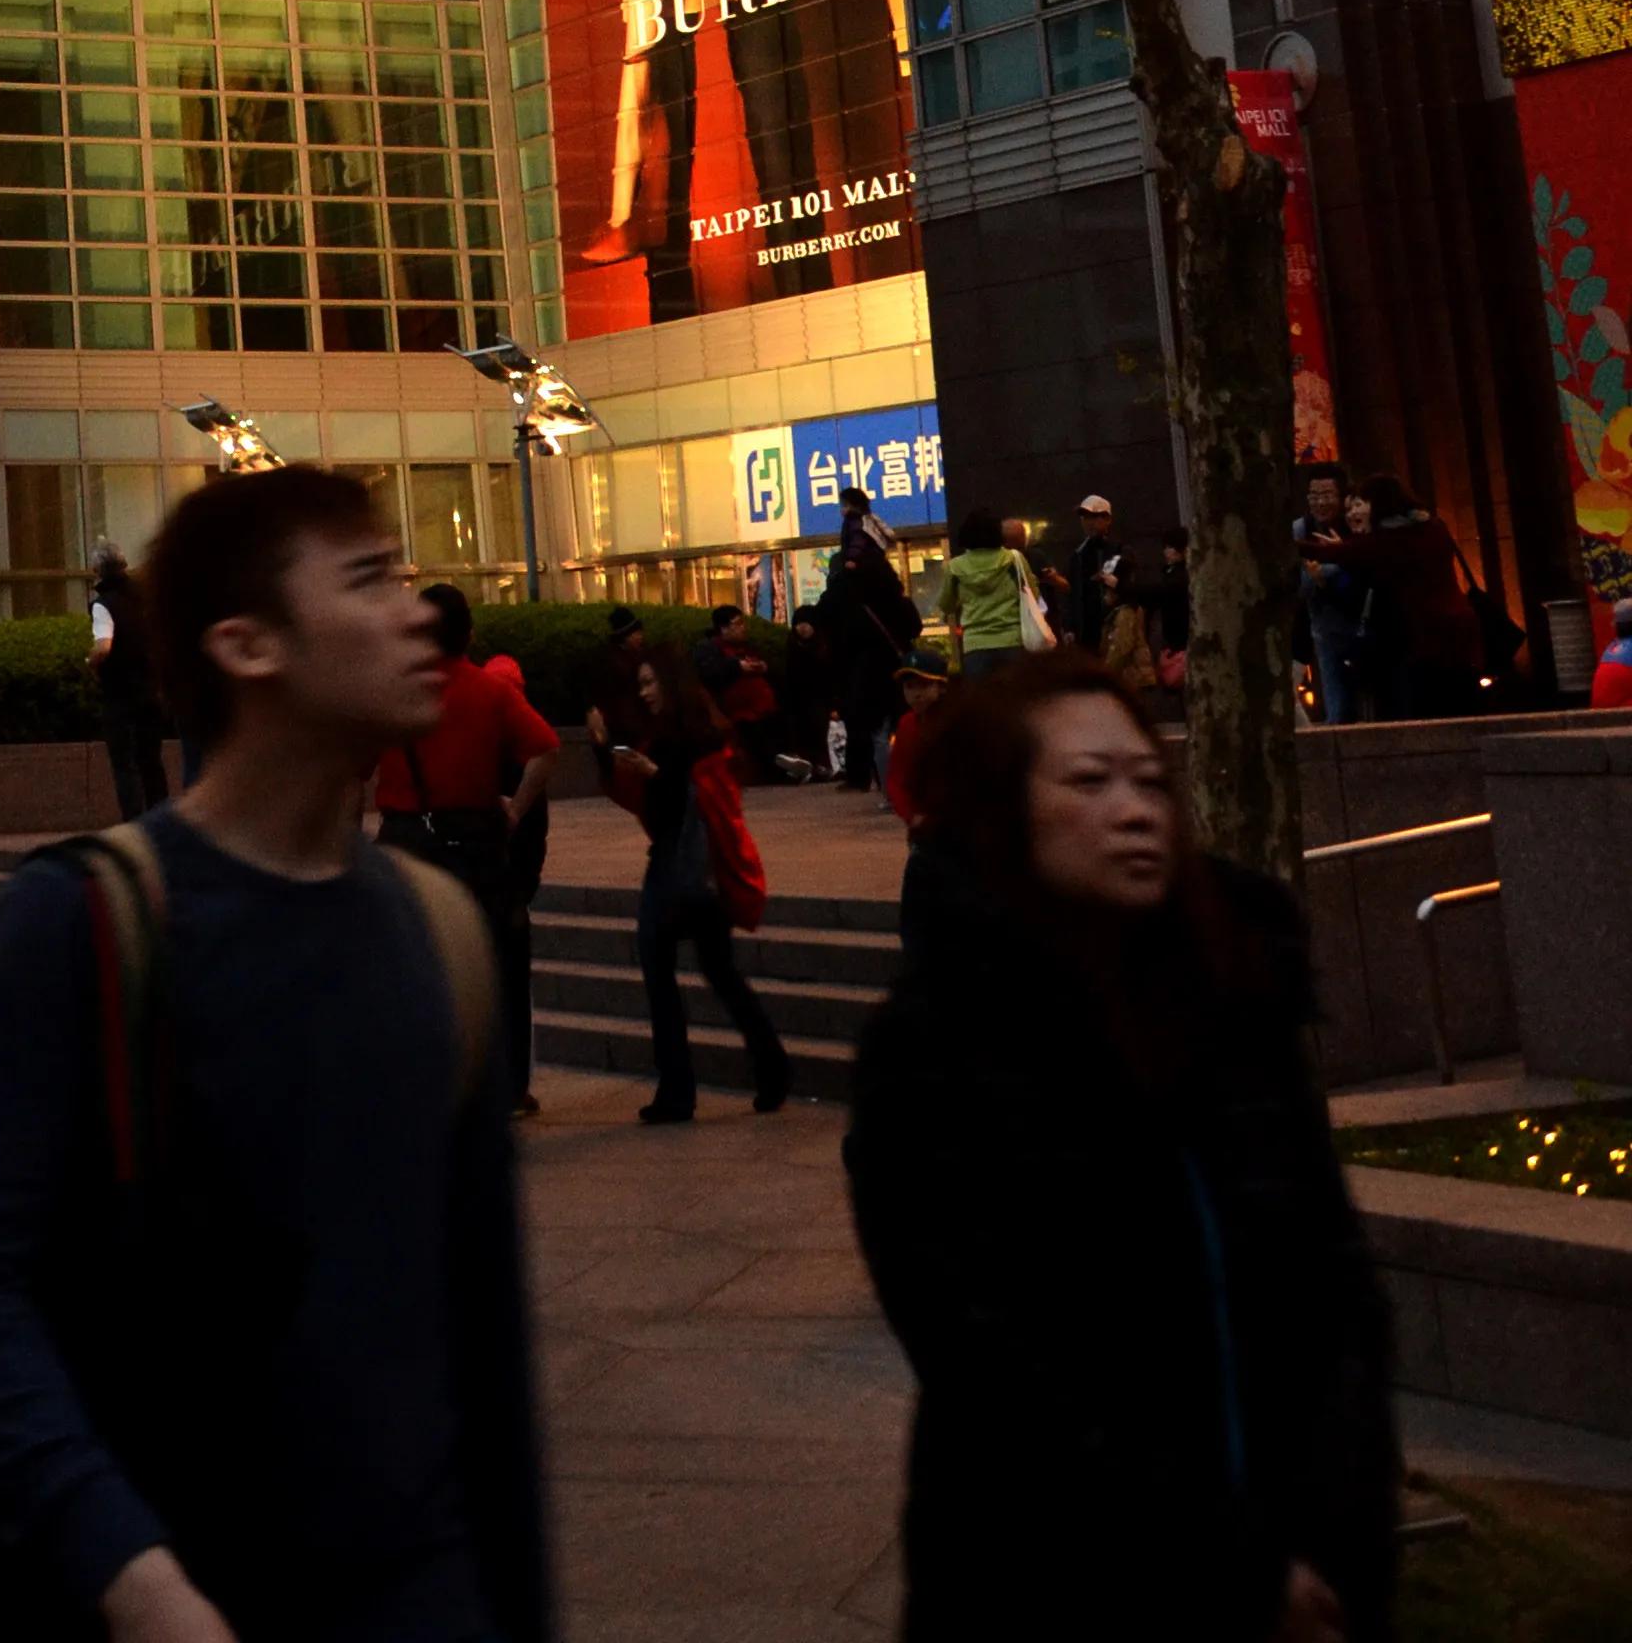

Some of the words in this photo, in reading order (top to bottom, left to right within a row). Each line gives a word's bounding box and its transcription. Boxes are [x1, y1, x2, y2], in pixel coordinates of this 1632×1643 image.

[1255, 122, 1291, 137] MALL
[690, 200, 784, 241] TAIPEI
[790, 189, 834, 219] 101
[757, 220, 902, 266] BURBERRY.COM
